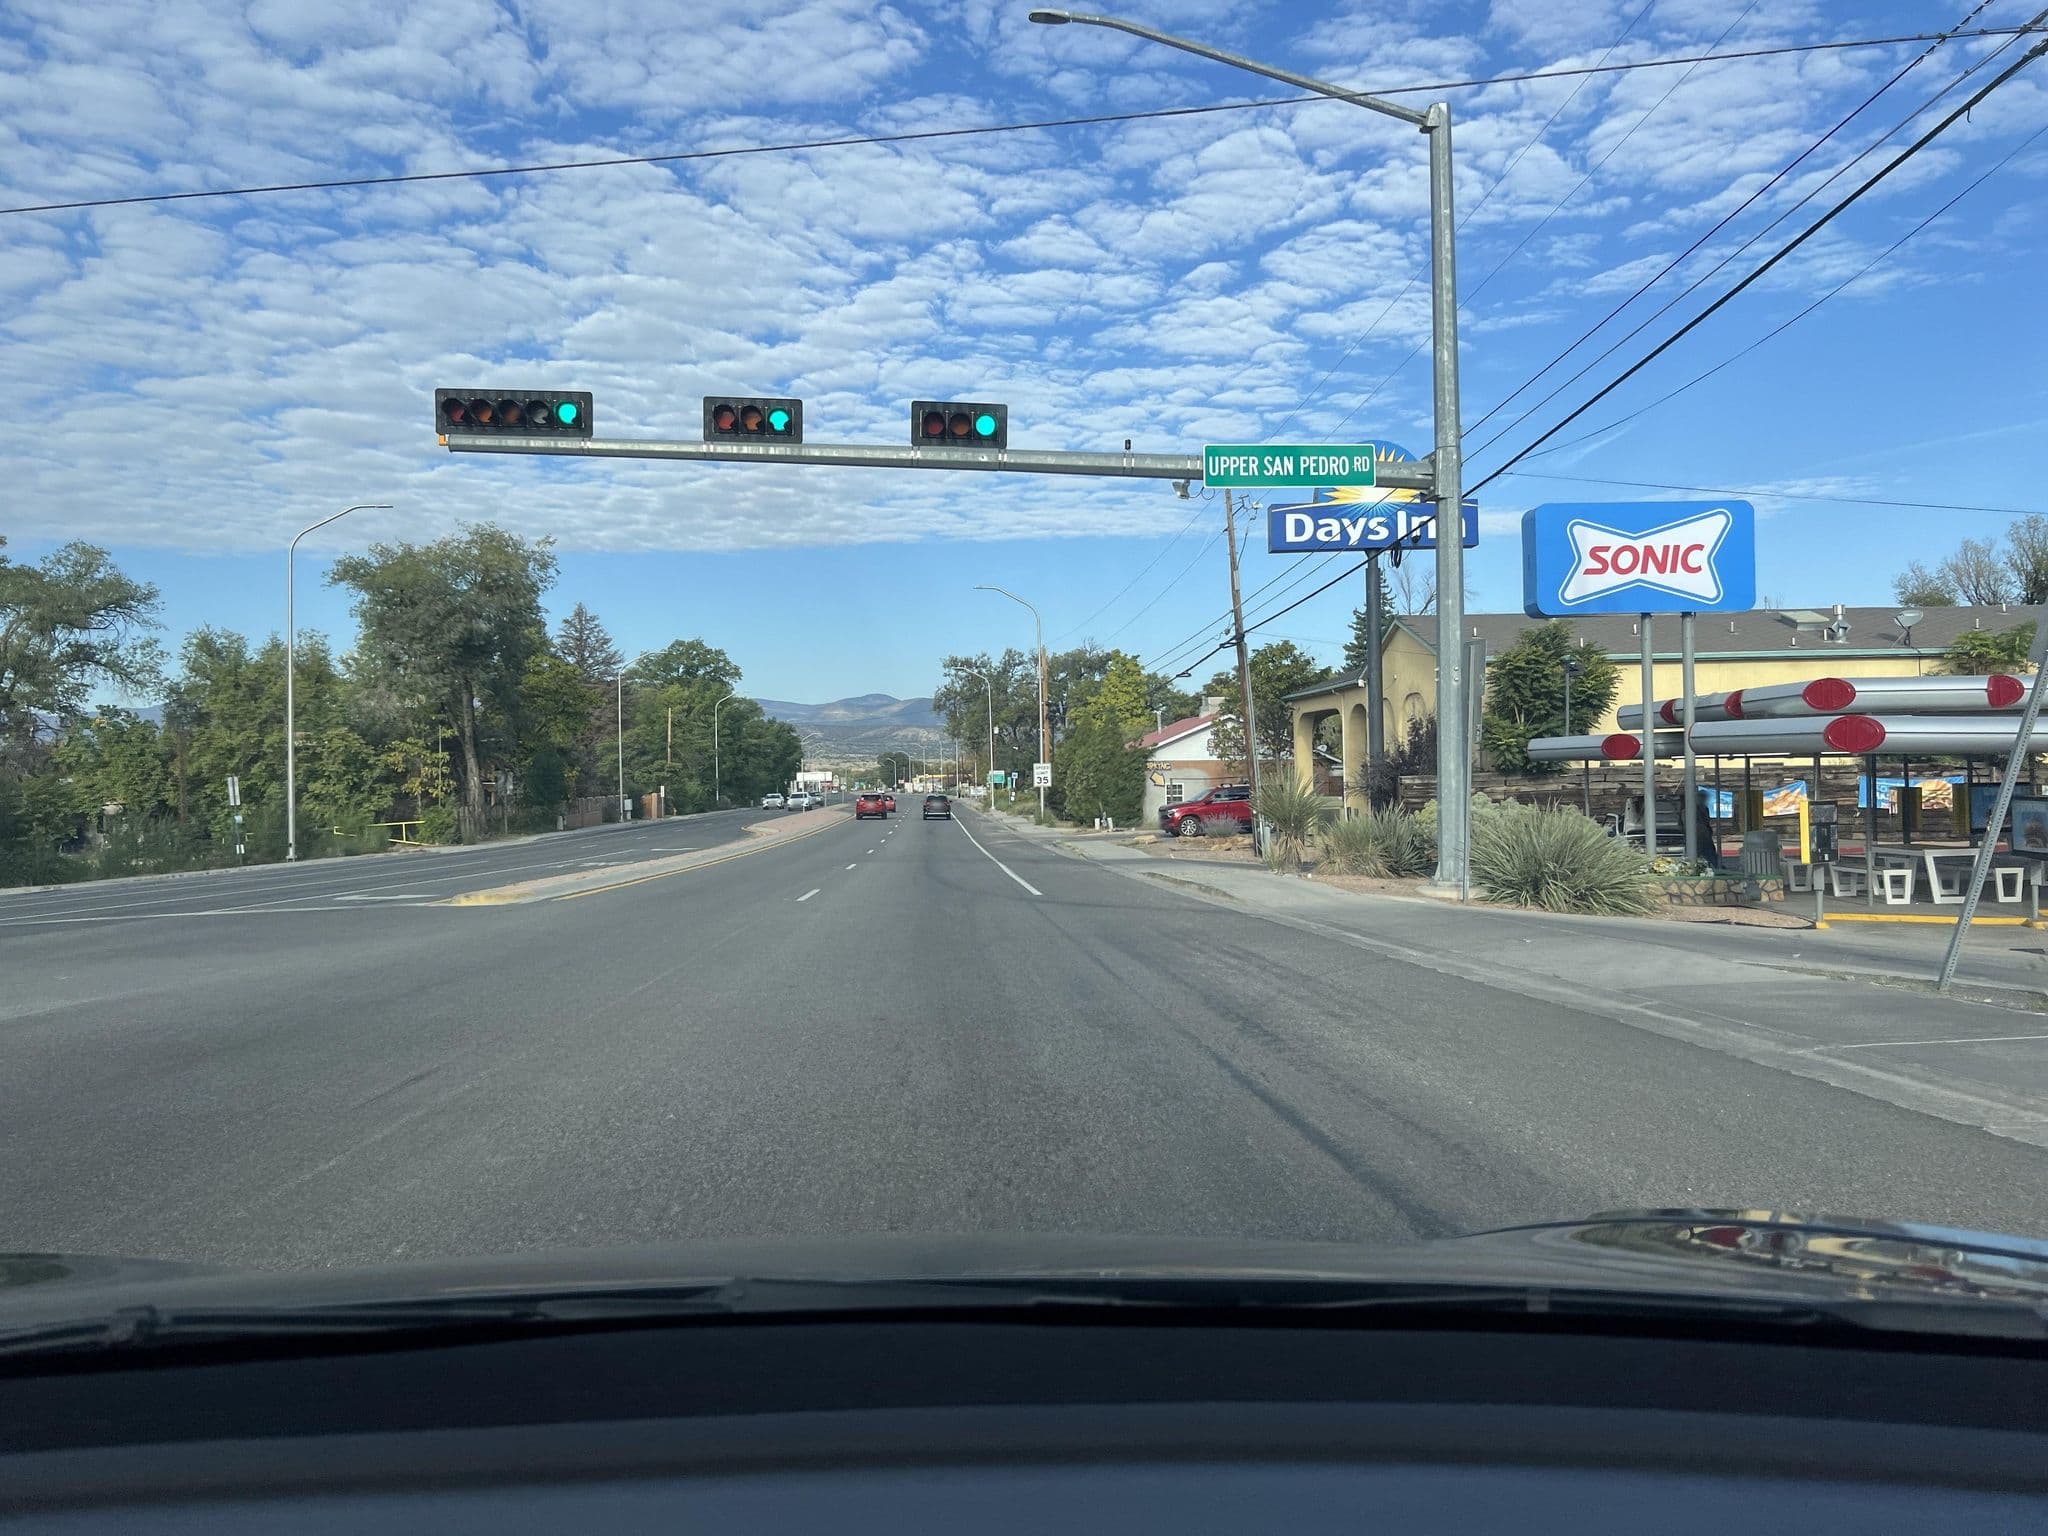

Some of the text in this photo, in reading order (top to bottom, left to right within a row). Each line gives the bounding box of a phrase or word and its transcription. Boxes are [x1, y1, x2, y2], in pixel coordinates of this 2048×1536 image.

[1209, 455, 1370, 476] UPPER SAN PEDRO RD
[1286, 511, 1466, 545] Days In
[1583, 544, 1705, 575] SONIC
[1036, 776, 1049, 785] 35
